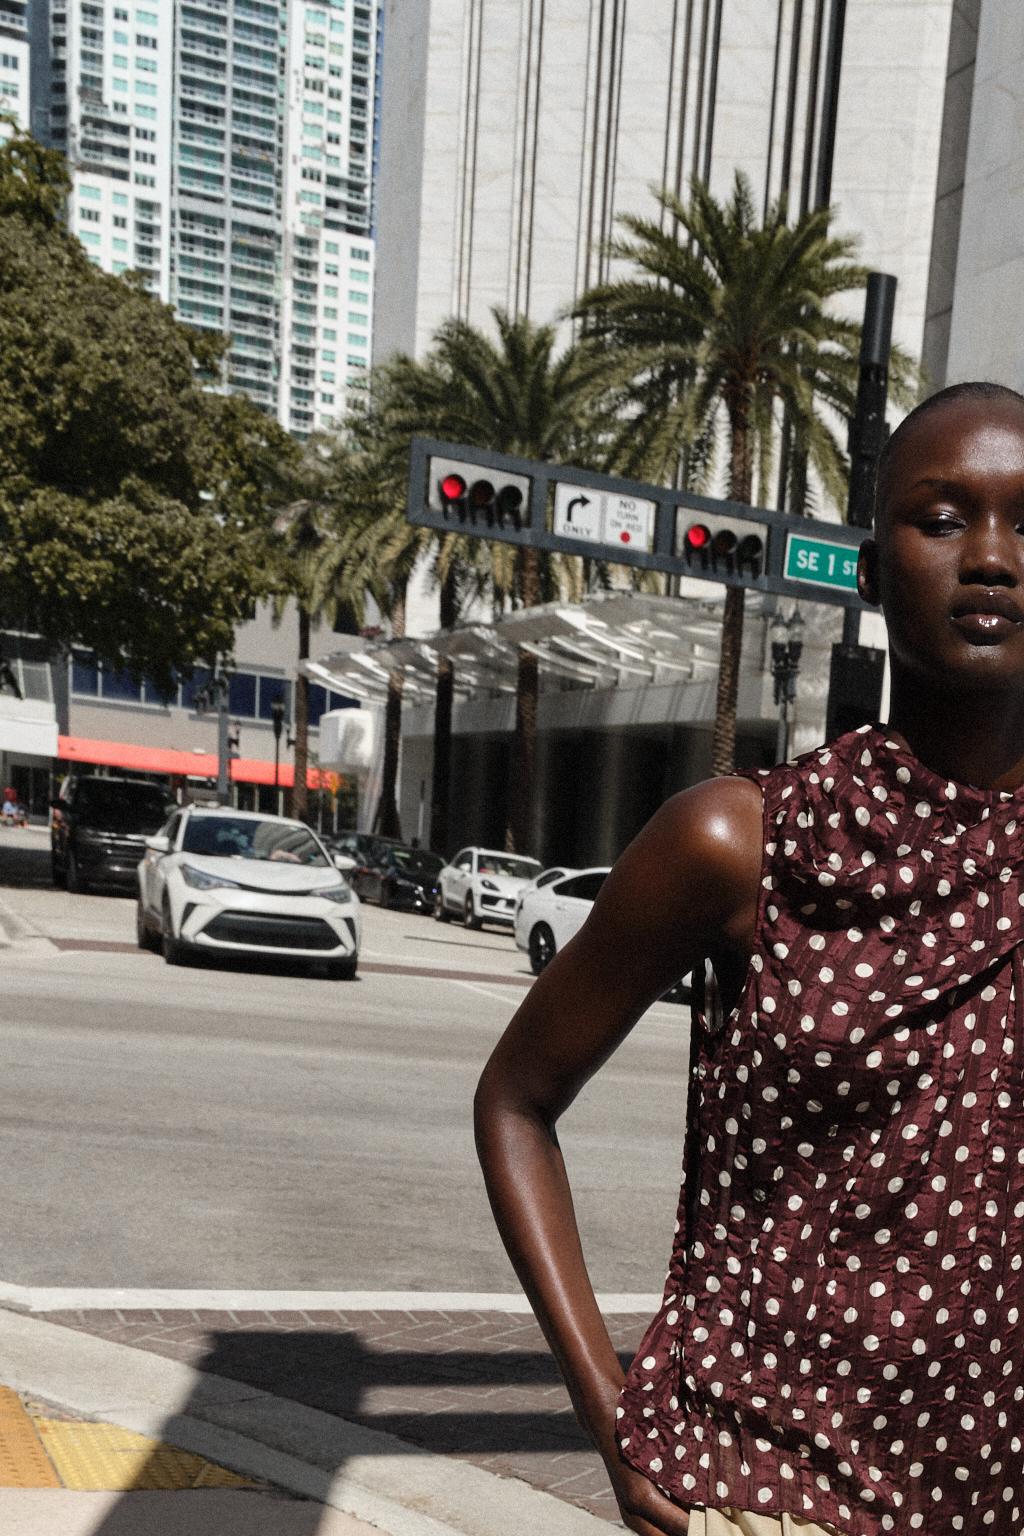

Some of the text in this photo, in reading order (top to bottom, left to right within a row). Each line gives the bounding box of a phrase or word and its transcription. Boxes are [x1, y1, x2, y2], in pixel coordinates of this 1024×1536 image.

[620, 500, 636, 511] NO
[563, 524, 592, 536] ONLY
[797, 549, 858, 577] SE 1 ST
